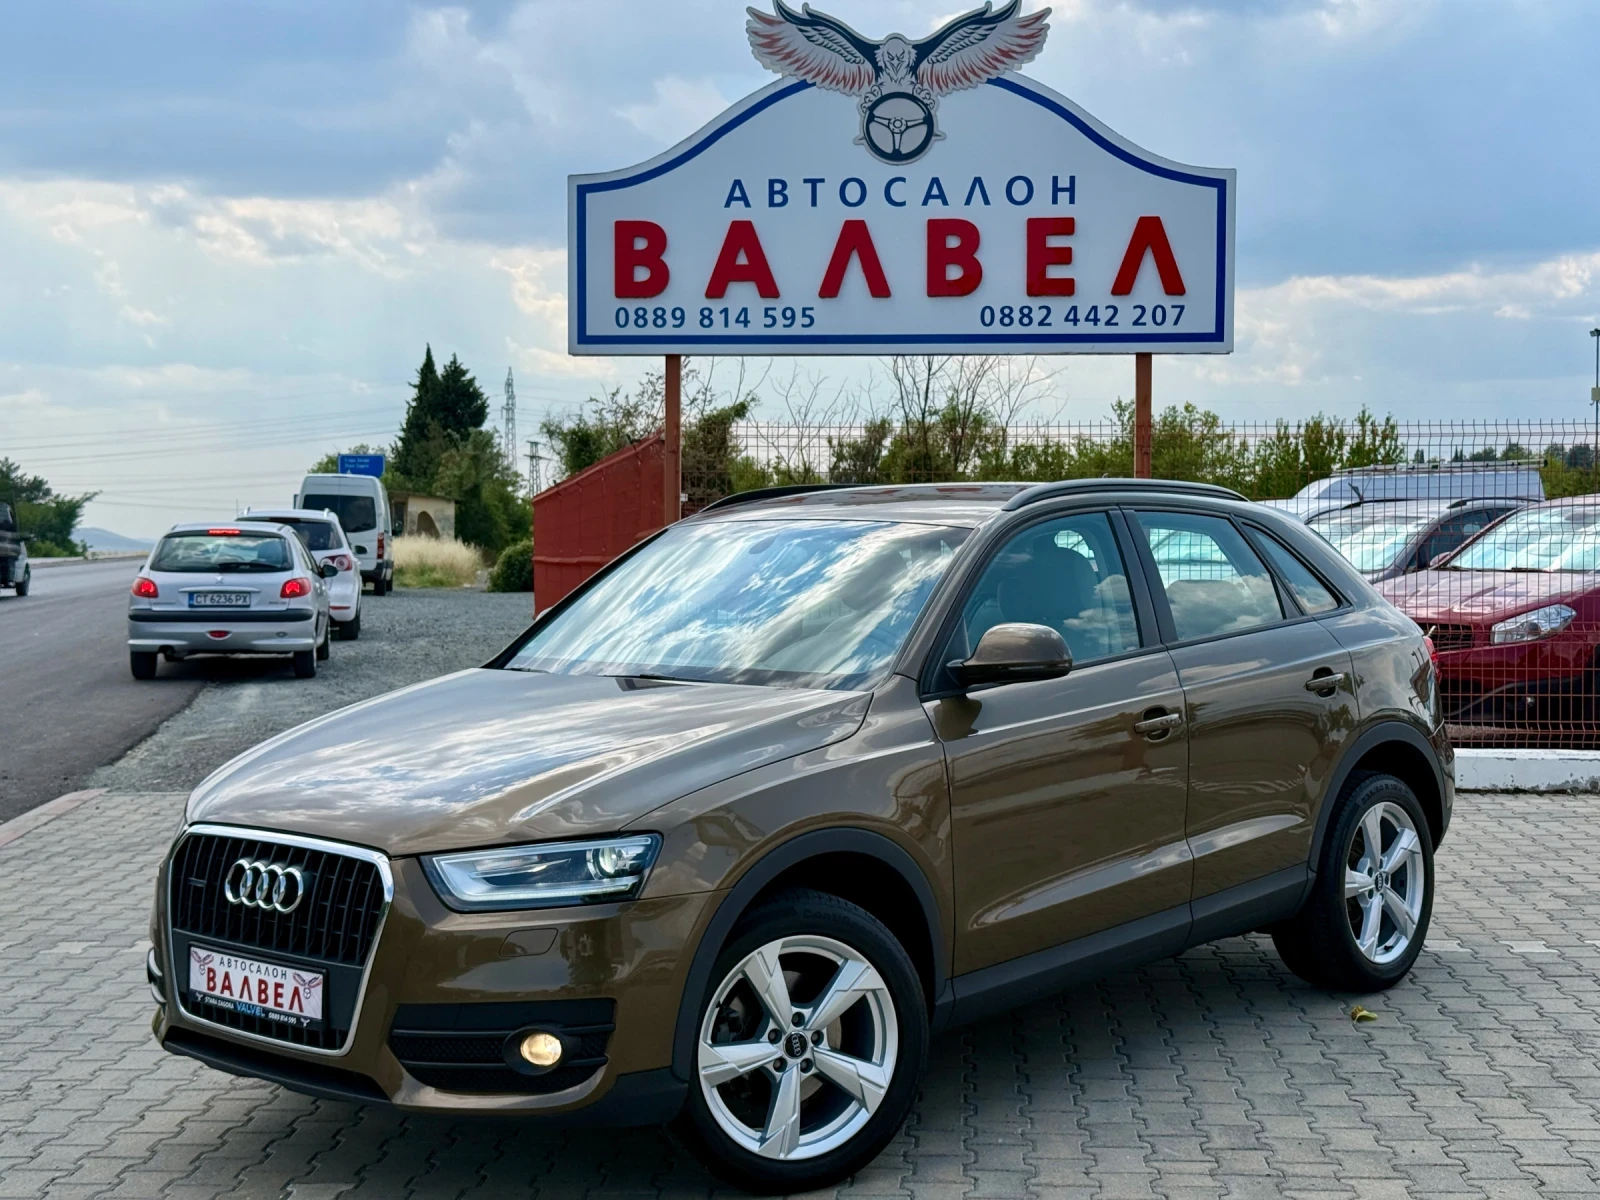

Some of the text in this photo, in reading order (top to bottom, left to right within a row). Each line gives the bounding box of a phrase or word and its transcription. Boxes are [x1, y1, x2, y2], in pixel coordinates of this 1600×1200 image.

[724, 174, 1077, 209] АВТОСАЛОН
[614, 216, 1186, 298] ВАЛВЕЛ
[614, 306, 815, 329] 0889 814 595
[979, 303, 1186, 328] 0882 442 207
[210, 594, 233, 604] 6236
[219, 956, 287, 980] АВТОСАЛОН
[206, 966, 304, 1013] ВАЛВЕЛ
[236, 1001, 265, 1017] VALVEL
